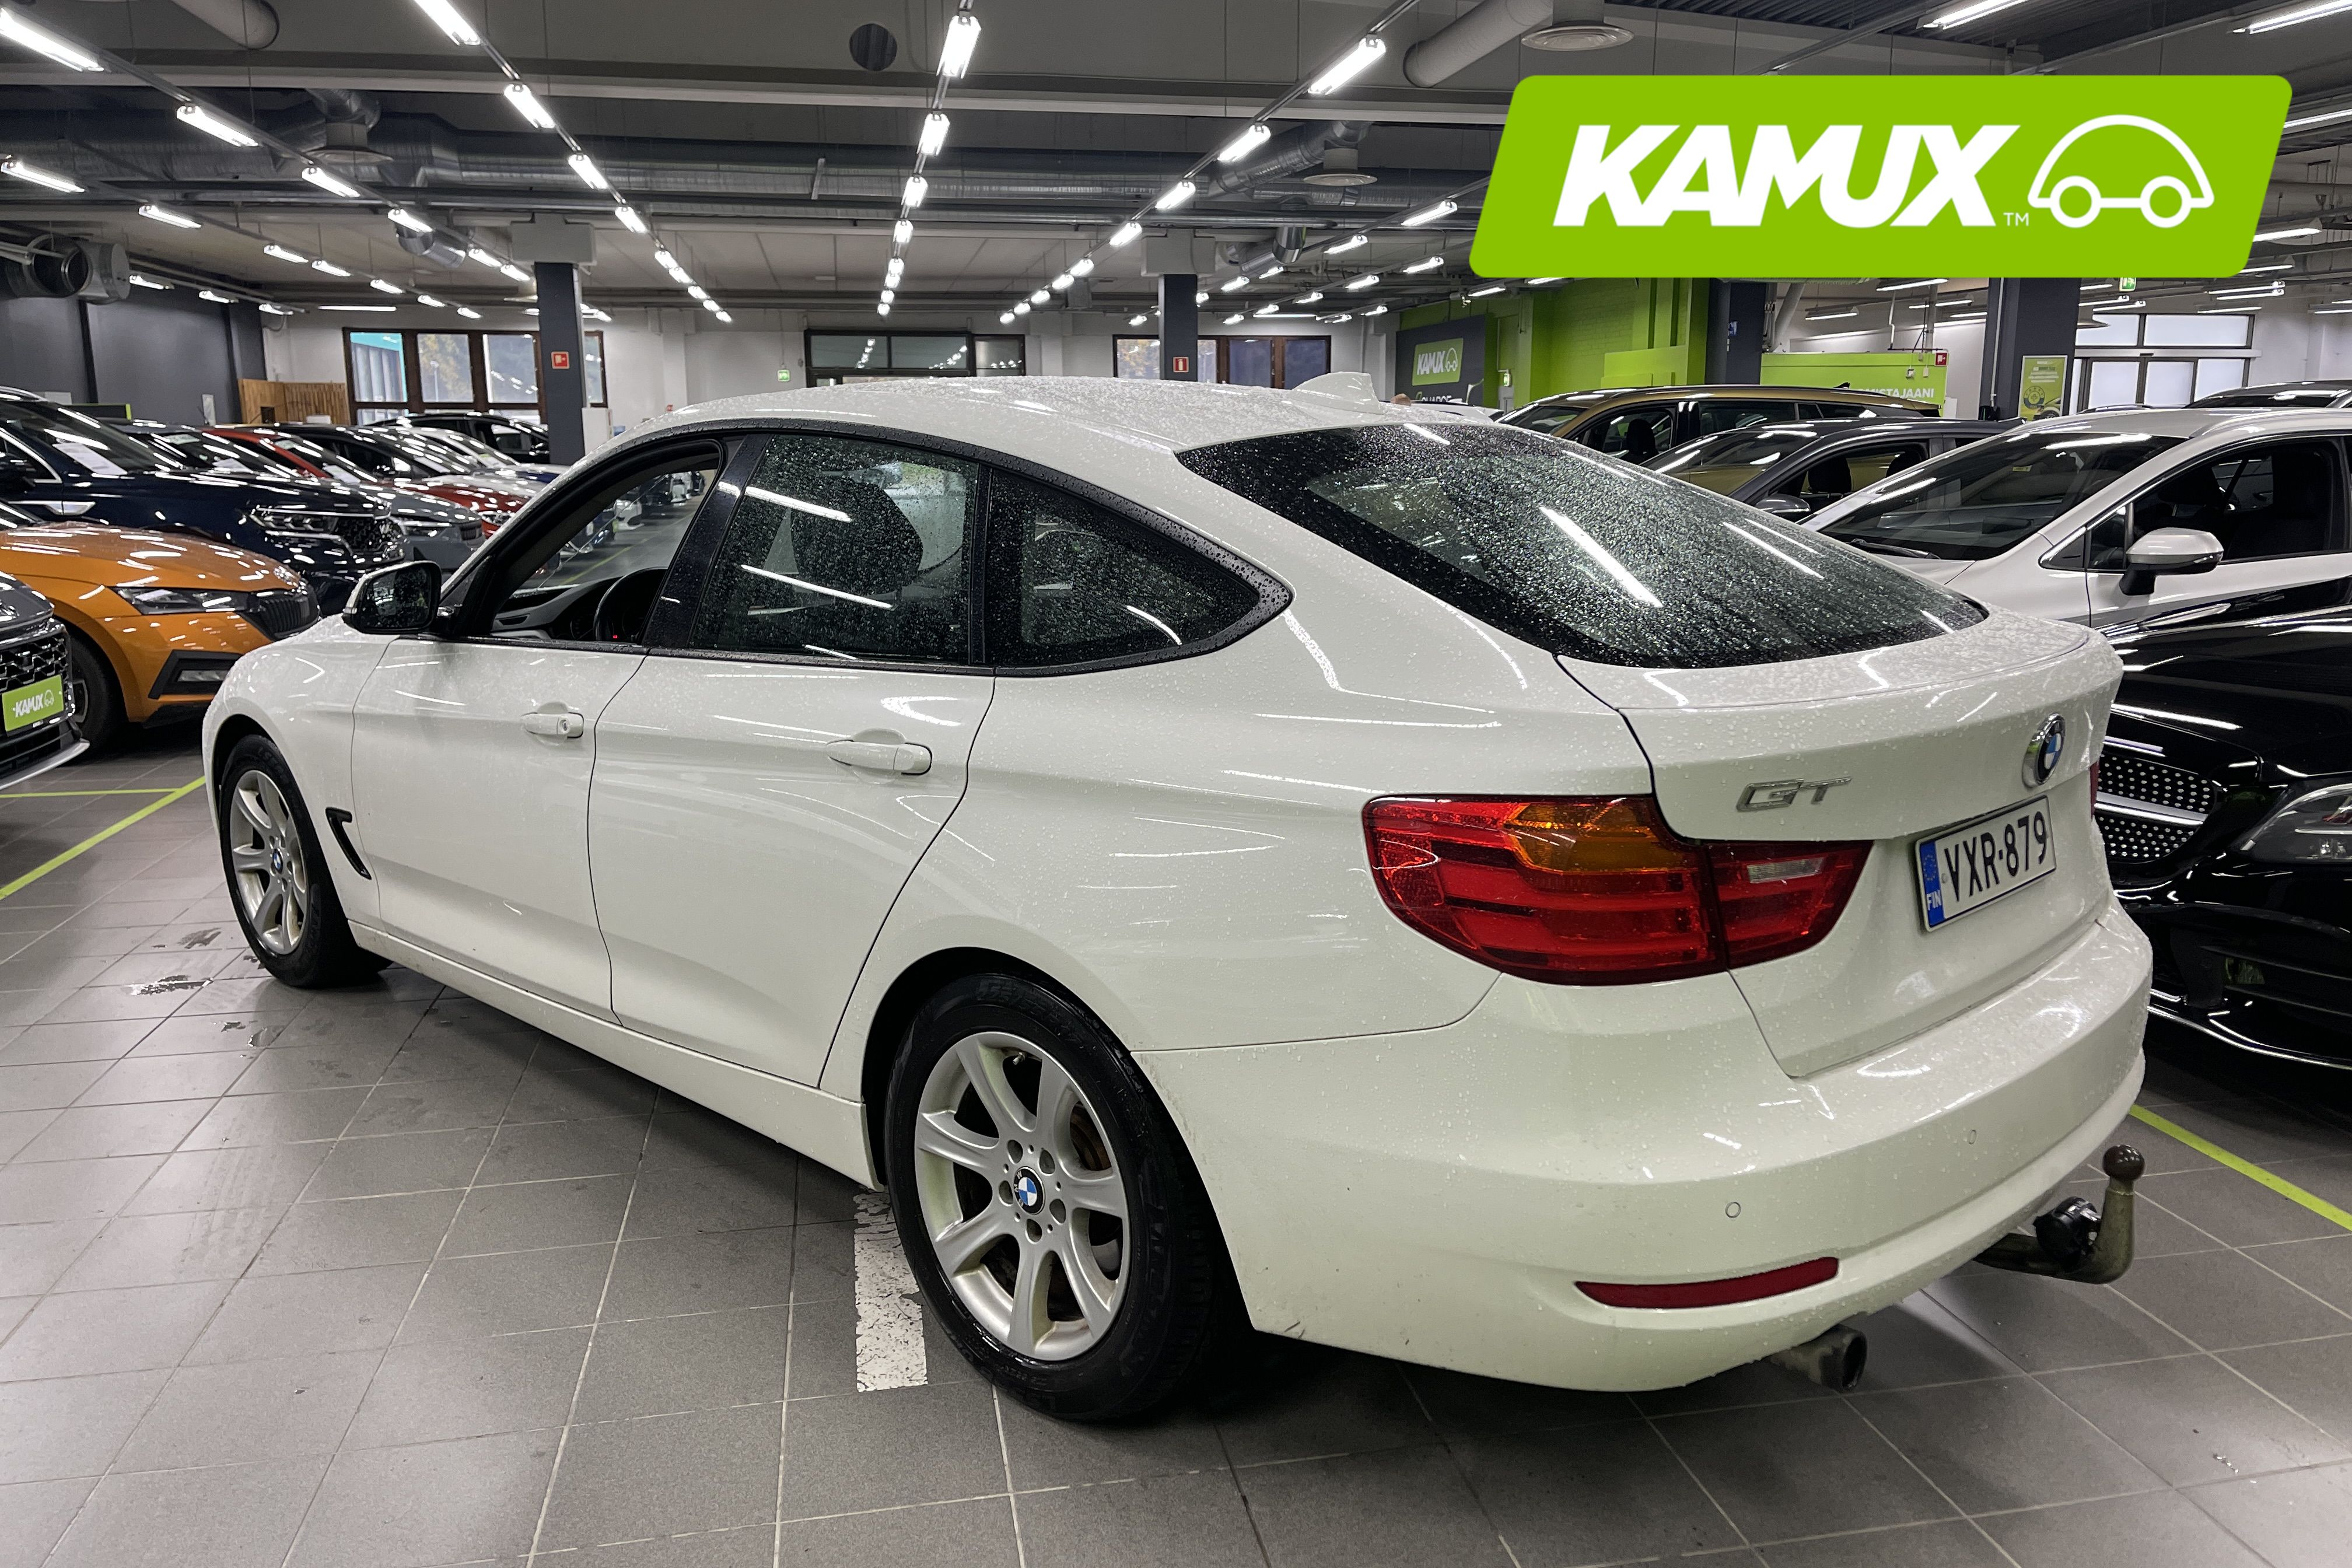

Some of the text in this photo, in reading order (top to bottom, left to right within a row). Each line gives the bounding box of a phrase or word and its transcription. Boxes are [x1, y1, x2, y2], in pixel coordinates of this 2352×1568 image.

[1417, 351, 1445, 374] KAMUX
[1857, 388, 1934, 398] STAJAANI
[15, 693, 44, 718] KAMUX
[1736, 776, 1852, 813] GT
[1944, 811, 2047, 902] VXR-879
[1926, 890, 1942, 911] FIN
